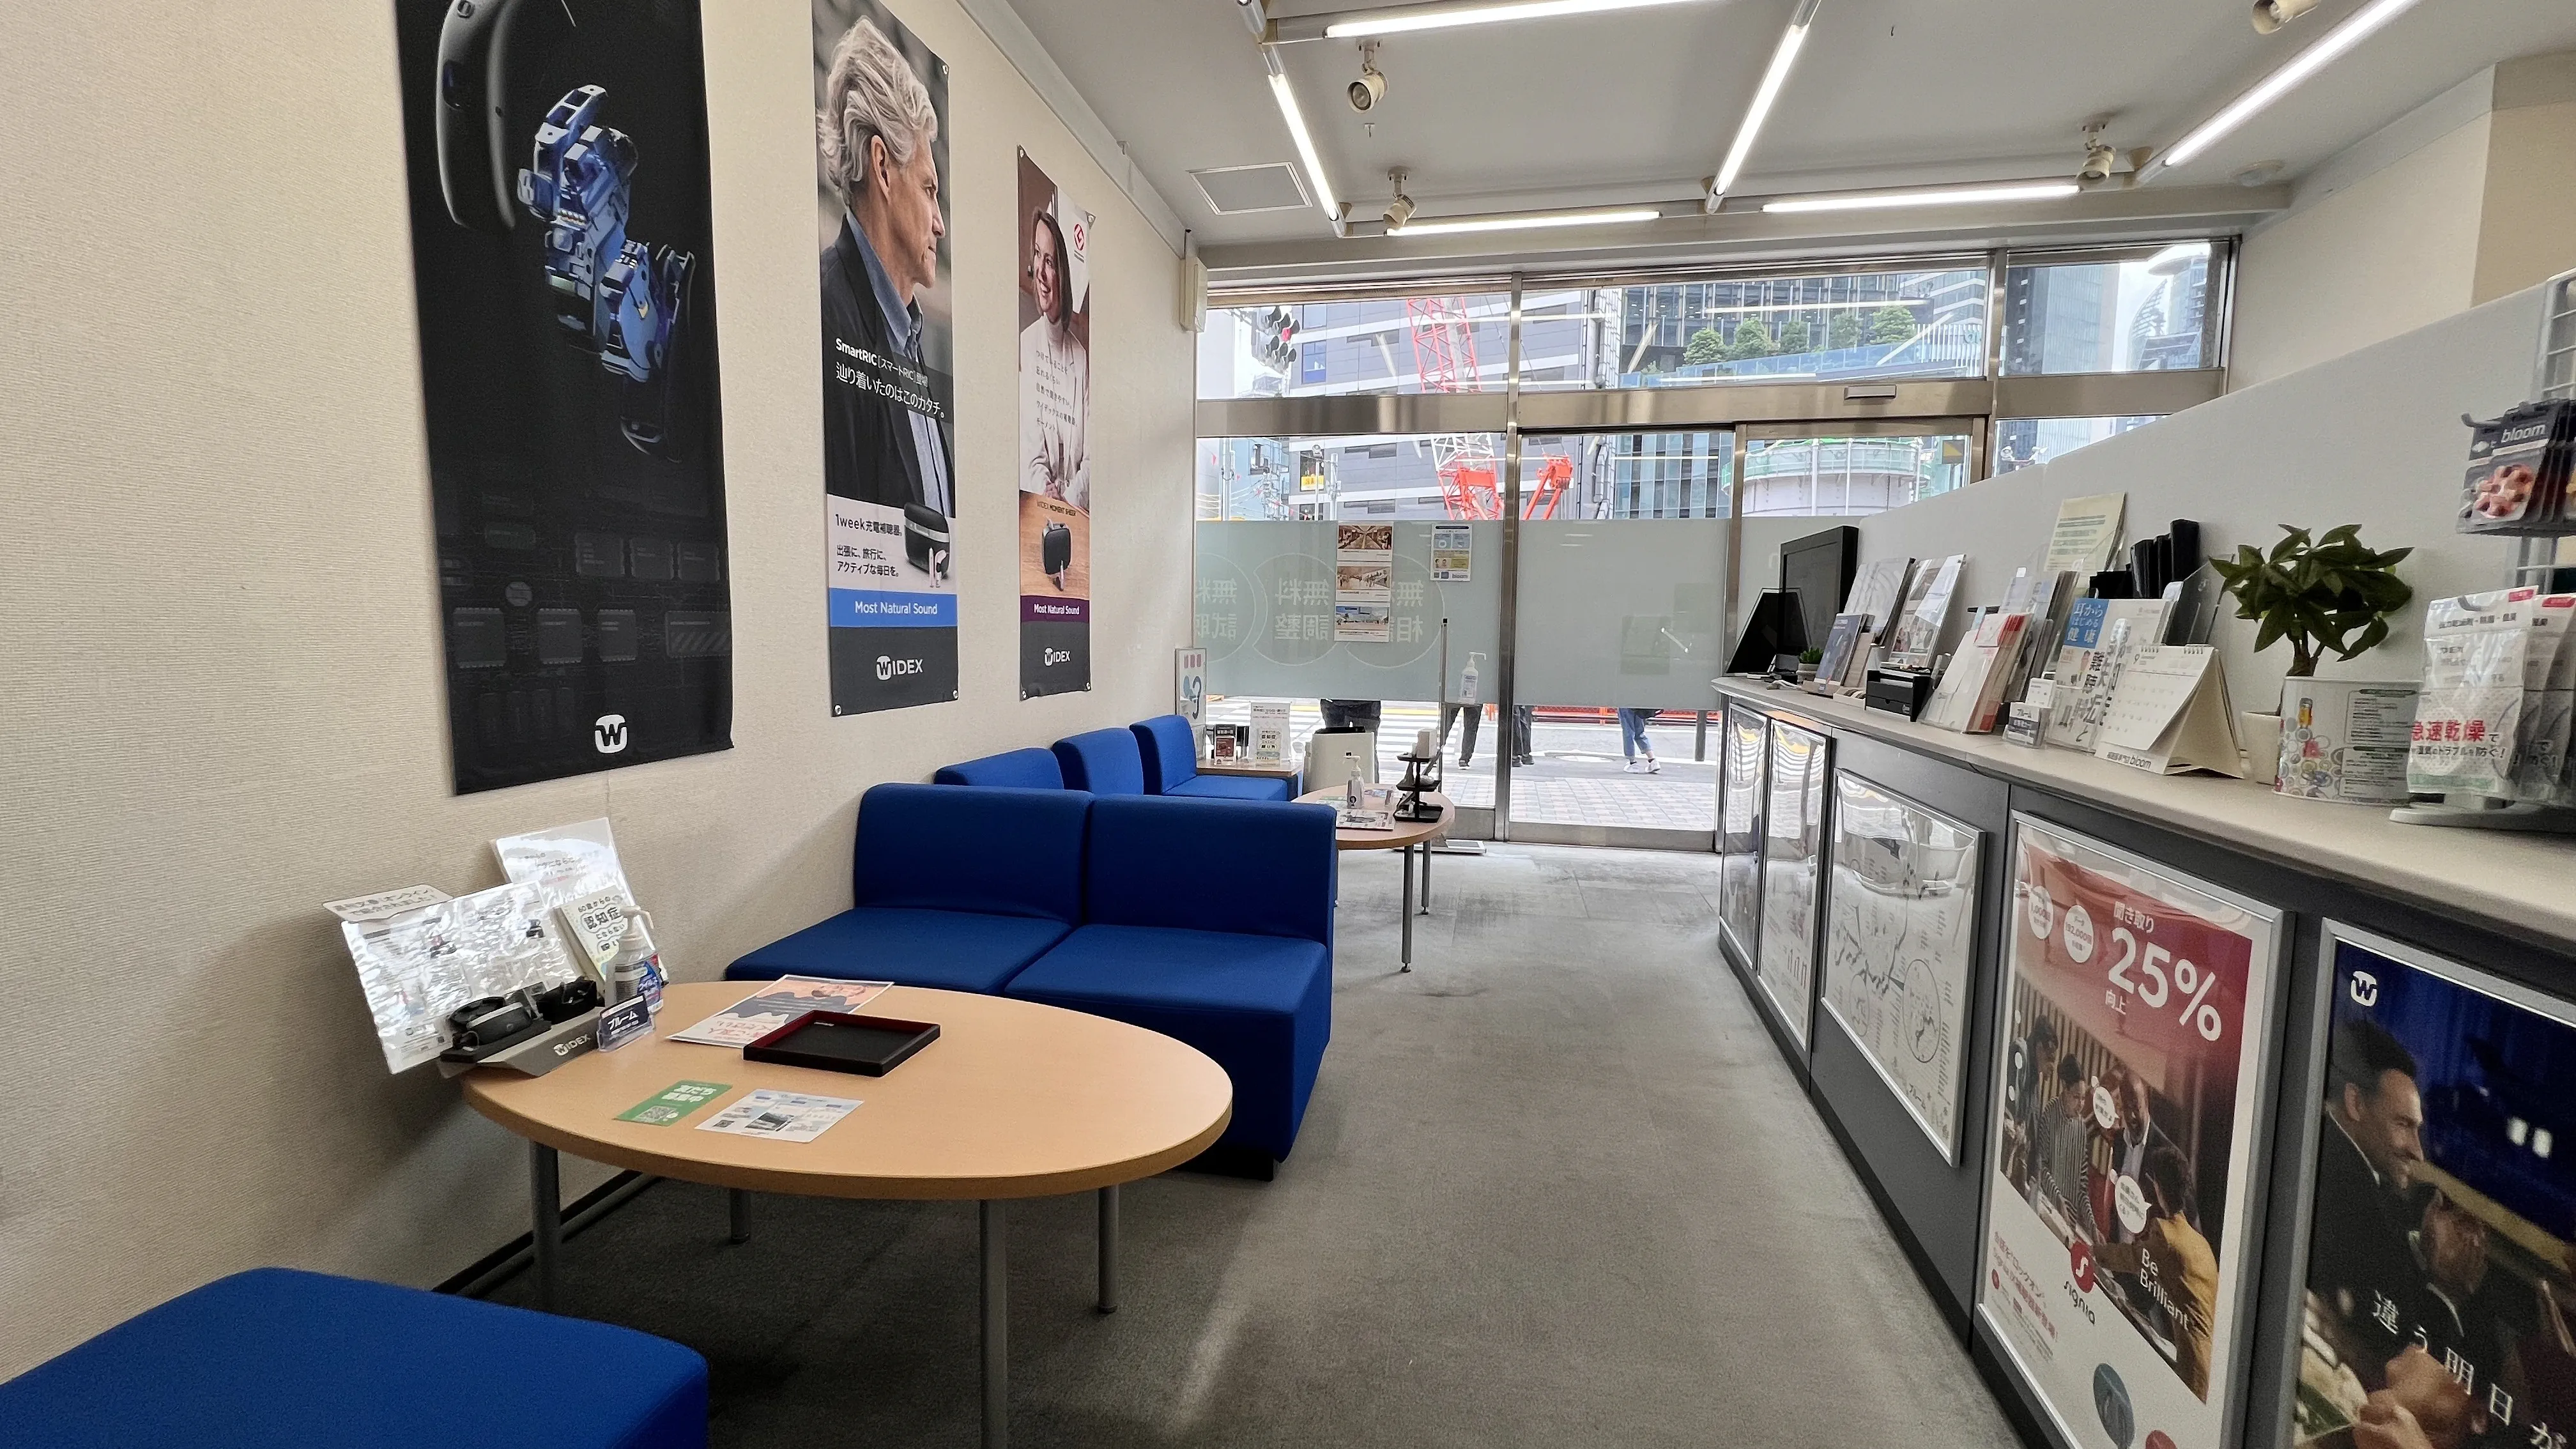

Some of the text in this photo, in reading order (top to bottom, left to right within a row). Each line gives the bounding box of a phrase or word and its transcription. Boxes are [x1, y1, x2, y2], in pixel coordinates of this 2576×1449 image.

[836, 362, 945, 418] 辿り着いたのはこのカタチ。
[2501, 424, 2546, 443] bloom
[837, 561, 900, 577] アクティブな毎日を。
[855, 601, 938, 615] Most Natural Sound
[1034, 604, 1080, 615] Most Natural Sound
[2074, 603, 2103, 618] 耳から
[2071, 617, 2099, 628] はじめる
[877, 656, 923, 680] WIDEX
[1045, 648, 1071, 666] WIDEX
[583, 907, 622, 930] 認知症
[2113, 901, 2154, 933] 聞き取り
[2108, 926, 2222, 1041] 25%
[2105, 988, 2128, 1015] 向上
[607, 1011, 639, 1031] ブルーム
[553, 1034, 591, 1056] WIDEX
[2142, 1248, 2159, 1276] Be
[2064, 1280, 2096, 1326] signia
[2140, 1268, 2190, 1330] Brilliant
